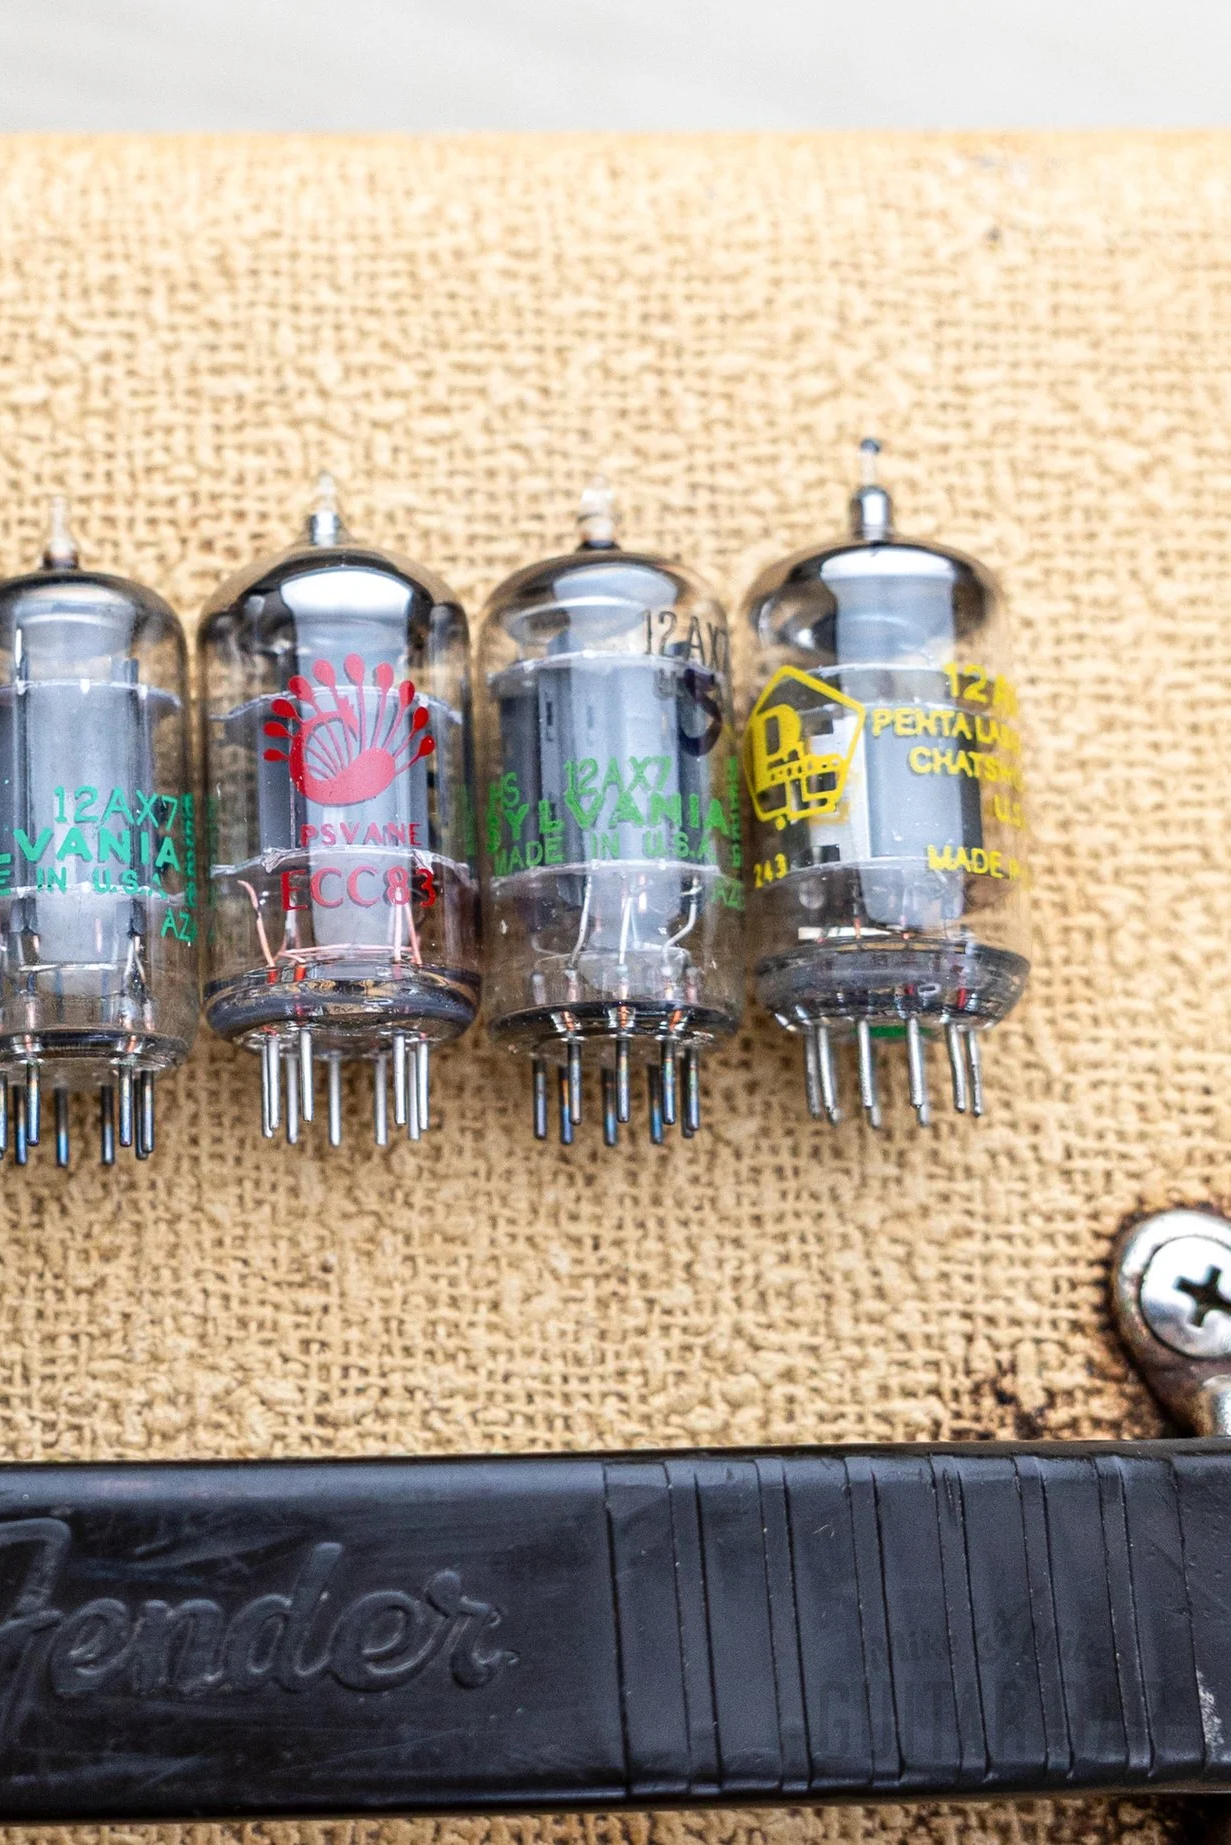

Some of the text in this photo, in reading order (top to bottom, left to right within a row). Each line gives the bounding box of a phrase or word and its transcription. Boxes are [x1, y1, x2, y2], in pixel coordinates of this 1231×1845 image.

[564, 755, 674, 798] 12AX7
[53, 786, 178, 831] 12AX7
[299, 821, 424, 848] PSVANE
[590, 831, 620, 861] IN
[926, 844, 1004, 879] MADE
[36, 866, 67, 893] IN
[279, 864, 438, 913] ECC83
